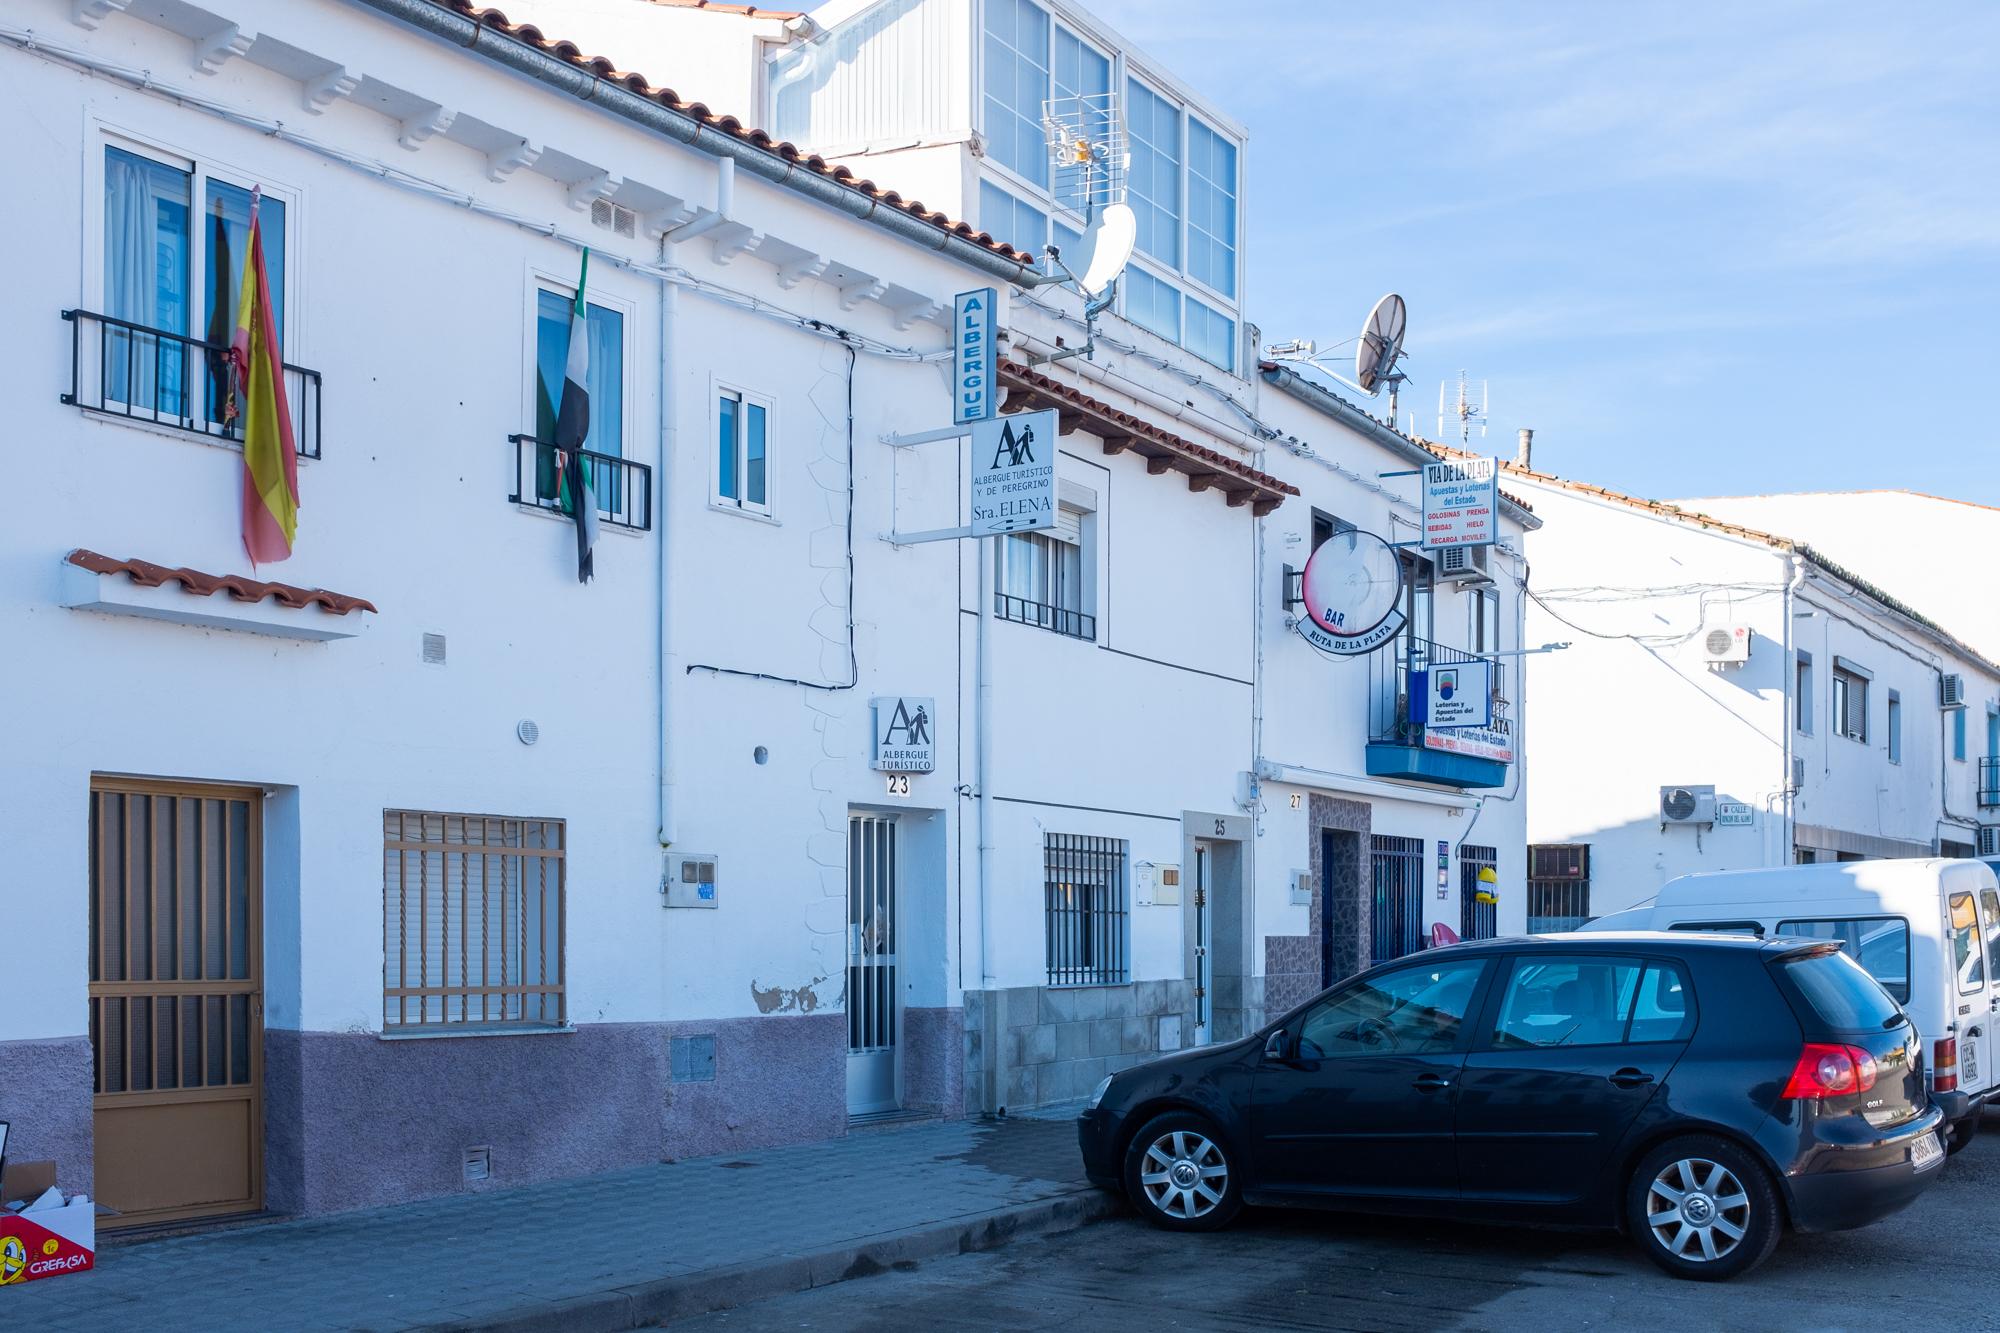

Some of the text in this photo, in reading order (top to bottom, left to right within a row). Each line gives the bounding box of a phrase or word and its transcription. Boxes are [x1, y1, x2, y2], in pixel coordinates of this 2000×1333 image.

[963, 297, 983, 418] ALBERGUE
[1428, 460, 1491, 484] VIA DE LA PLATA
[974, 472, 1010, 486] ALBERGUE
[977, 478, 1049, 497] Y DE PEREGRINO
[1430, 485, 1458, 496] Apuestas
[1460, 486, 1464, 495] y
[1444, 495, 1476, 506] del Estado
[974, 496, 1051, 521] Sra. ELENA
[1428, 508, 1489, 520] GOLOSINAS PRENSA
[1428, 520, 1484, 532] BEBIDAS HIELO
[1431, 536, 1458, 545] RECARGA
[1325, 608, 1345, 628] BAR
[1310, 625, 1392, 650] RUTA DE LA PLATA
[1435, 708, 1463, 716] Apuestas
[1435, 715, 1455, 723] Estado
[1457, 729, 1460, 739] y
[1490, 734, 1506, 746] Estado
[883, 750, 929, 760] ALBERGUE
[881, 758, 931, 770] TURÍSTICO
[888, 774, 908, 794] 23
[1290, 794, 1301, 809] 27
[1731, 805, 1747, 814] CALLE
[1215, 819, 1226, 836] 25
[1867, 1099, 1884, 1109] GOLF
